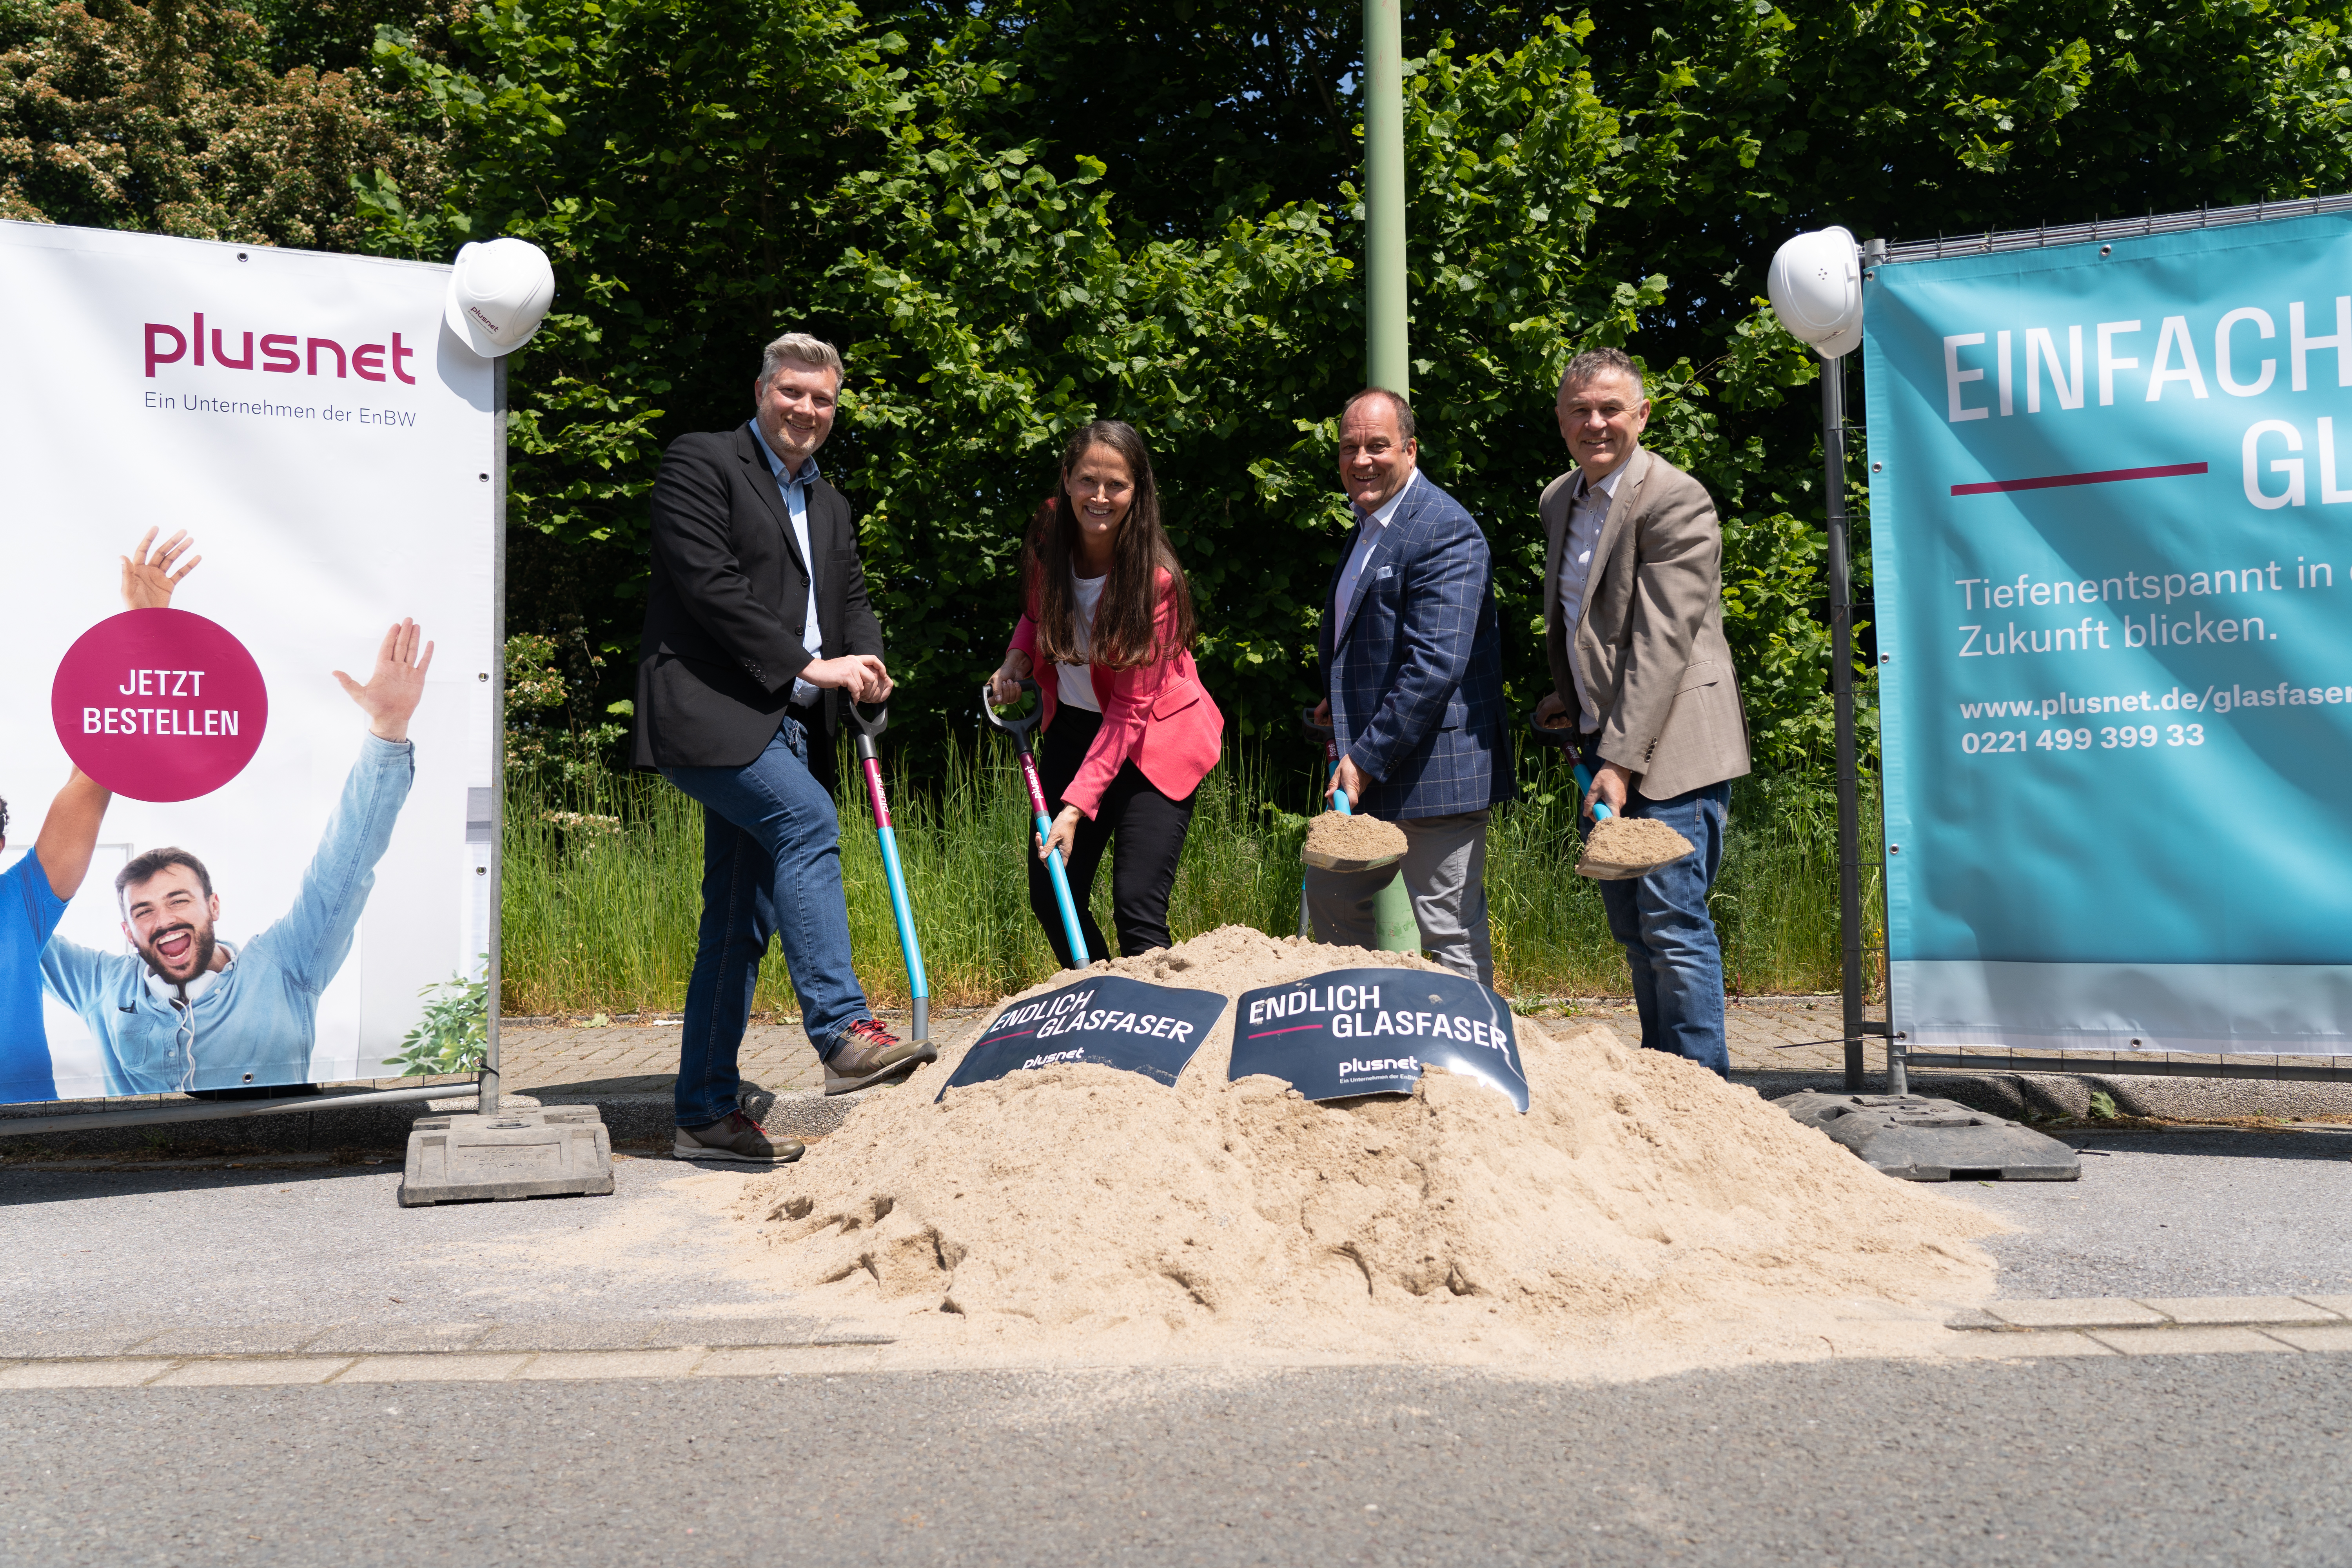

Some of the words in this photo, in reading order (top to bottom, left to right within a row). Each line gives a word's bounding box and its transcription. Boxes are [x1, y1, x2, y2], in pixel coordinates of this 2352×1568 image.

[470, 306, 499, 332] plusnet
[145, 312, 416, 385] plusnet
[1944, 296, 2352, 422] EINFACH
[145, 392, 175, 408] Ein
[184, 394, 315, 419] Unternehmen
[323, 405, 352, 421] der
[360, 408, 416, 427] EnBW
[2242, 416, 2352, 510] GL
[1955, 561, 2282, 610] Tiefenentspannt
[2298, 556, 2332, 588] in
[1958, 617, 2109, 657] Zukunft
[2124, 611, 2277, 648] blicken.
[120, 669, 205, 696] JETZT
[1960, 682, 2352, 720] www.plusnet.de/glasfaser
[83, 707, 238, 735] BESTELLEN
[1962, 730, 2027, 753] 0221
[2036, 728, 2092, 751] 499
[2100, 725, 2158, 749] 399
[2166, 723, 2205, 747] 33
[873, 773, 889, 813] plusnet
[1025, 764, 1044, 799] plusnet
[989, 990, 1094, 1033] ENDLICH
[1249, 985, 1379, 1024] ENDLICH
[1036, 1009, 1194, 1043] GLASFASER
[1332, 1011, 1509, 1053] GLASFASER
[1022, 1047, 1084, 1070] plusnet
[1339, 1056, 1418, 1076] plusnet
